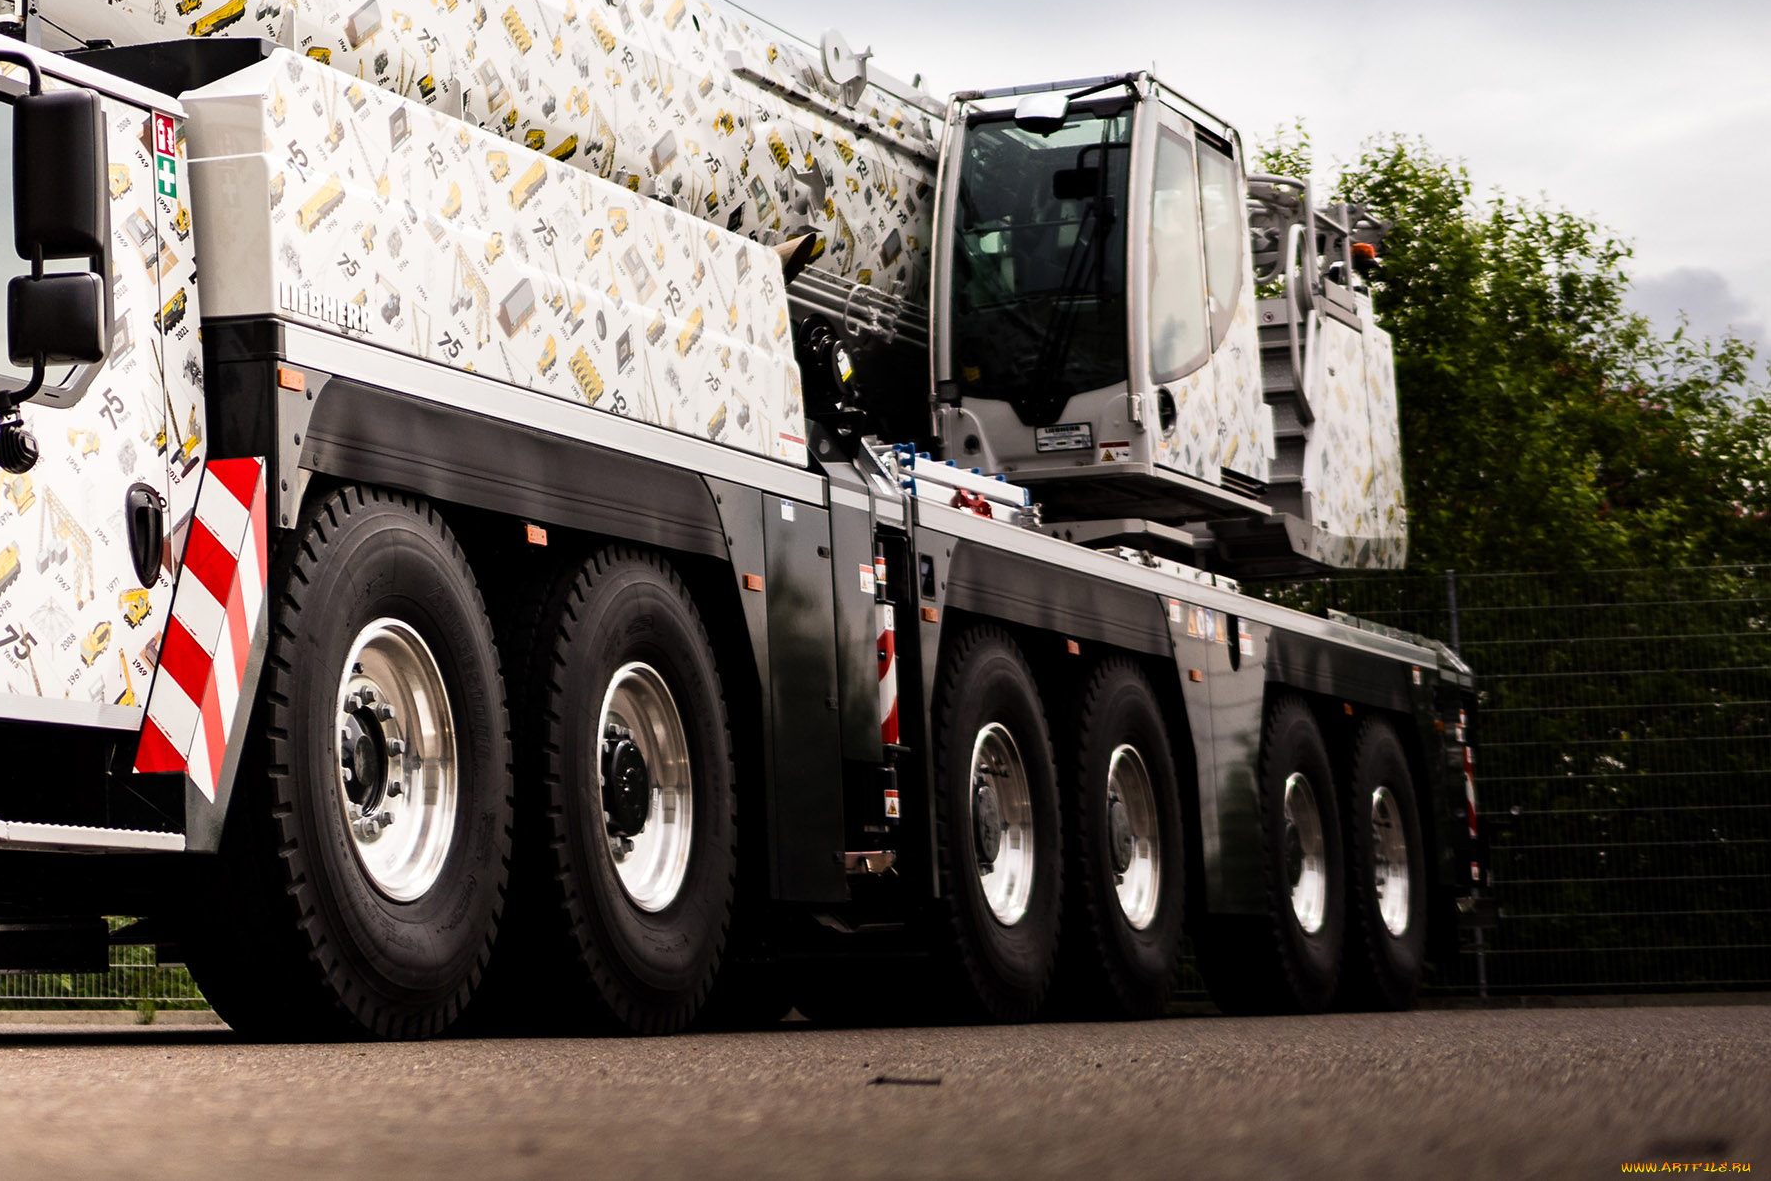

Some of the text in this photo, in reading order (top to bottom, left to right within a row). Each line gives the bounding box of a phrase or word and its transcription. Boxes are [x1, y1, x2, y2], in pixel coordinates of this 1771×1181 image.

[156, 196, 171, 214] 1959
[532, 217, 558, 247] 75
[336, 253, 361, 277] 75
[664, 280, 682, 317] 75
[175, 326, 190, 341] 2021
[437, 331, 464, 359] 75
[98, 387, 125, 430] 75
[60, 633, 77, 651] 2008
[66, 669, 83, 686] 1967
[132, 658, 148, 677] 1969
